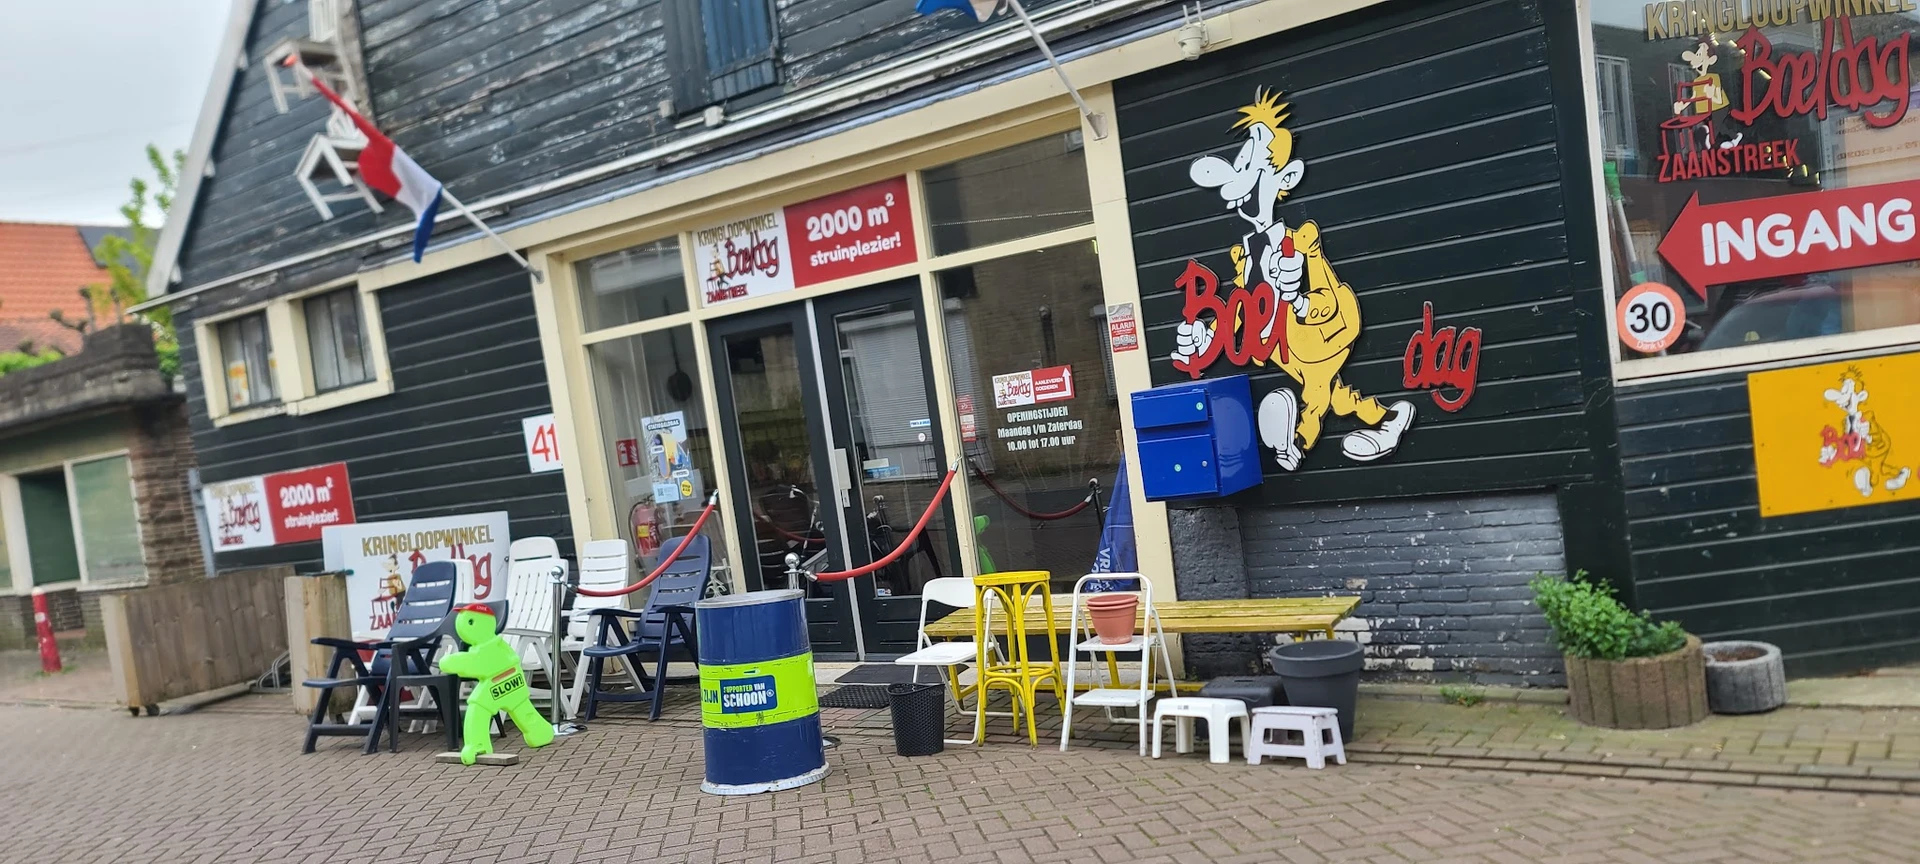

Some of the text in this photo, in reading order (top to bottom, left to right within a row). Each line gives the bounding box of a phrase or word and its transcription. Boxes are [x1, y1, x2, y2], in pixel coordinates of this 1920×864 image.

[1644, 0, 1917, 40] KRINGLOOPWI
[1730, 16, 1911, 127] Boeldag
[1657, 139, 1802, 183] ZAANSTREEK
[697, 212, 779, 247] KRINGLOOPWINKEL
[806, 205, 863, 242] 2000
[1702, 198, 1916, 266] INGANG
[725, 230, 779, 279] Boeldag
[810, 231, 902, 267] struinplezier!
[1111, 321, 1135, 331] ALARM
[1630, 301, 1671, 334] 30
[1403, 301, 1482, 413] dag
[1034, 377, 1064, 386] AANLEVEREN
[997, 419, 1083, 439] Maandag t/m Zaterdag
[1007, 406, 1068, 423] OPENINGSTIJDEN
[531, 423, 559, 462] 41
[1007, 435, 1076, 451] 10.00 tot 17.00 uur
[279, 482, 314, 509] 2000
[361, 525, 495, 557] KRINGLOOPWINKEL
[492, 675, 523, 698] SLOW!
[703, 688, 719, 704] ZIJN
[753, 682, 766, 691] VAN
